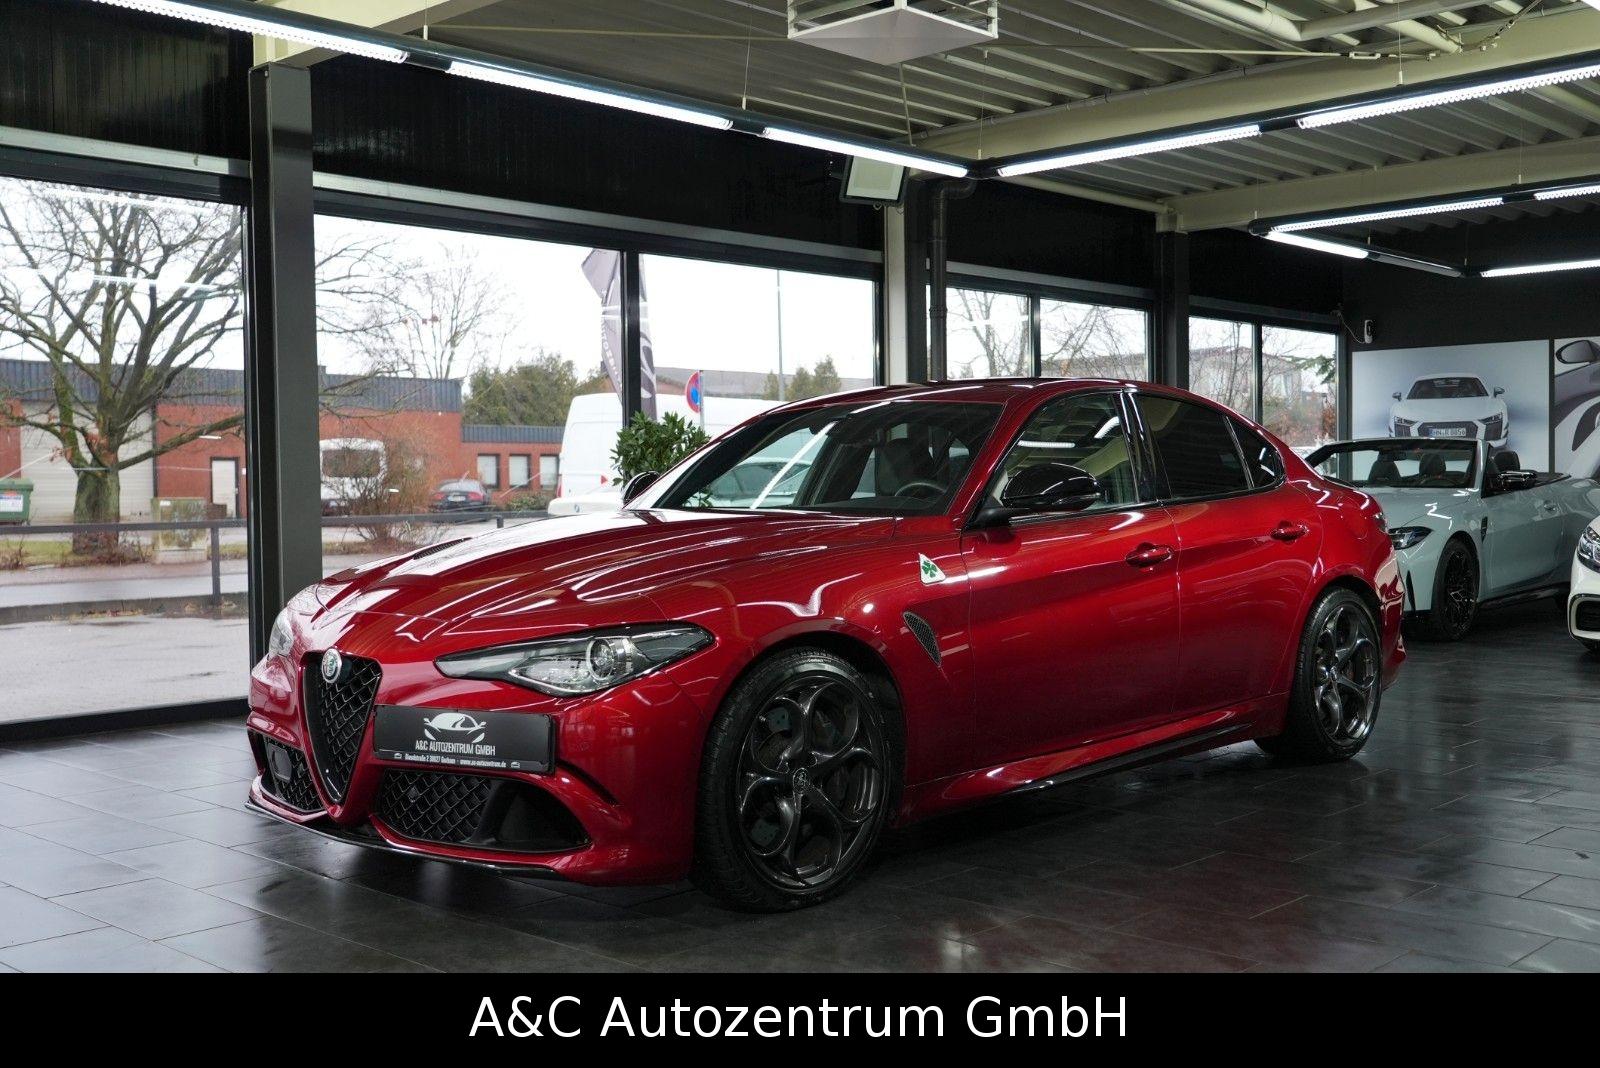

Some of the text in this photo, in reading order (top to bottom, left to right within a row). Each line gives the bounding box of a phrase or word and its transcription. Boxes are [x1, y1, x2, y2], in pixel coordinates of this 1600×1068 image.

[415, 740, 496, 756] A&C AUTOZENTRUM GMBH
